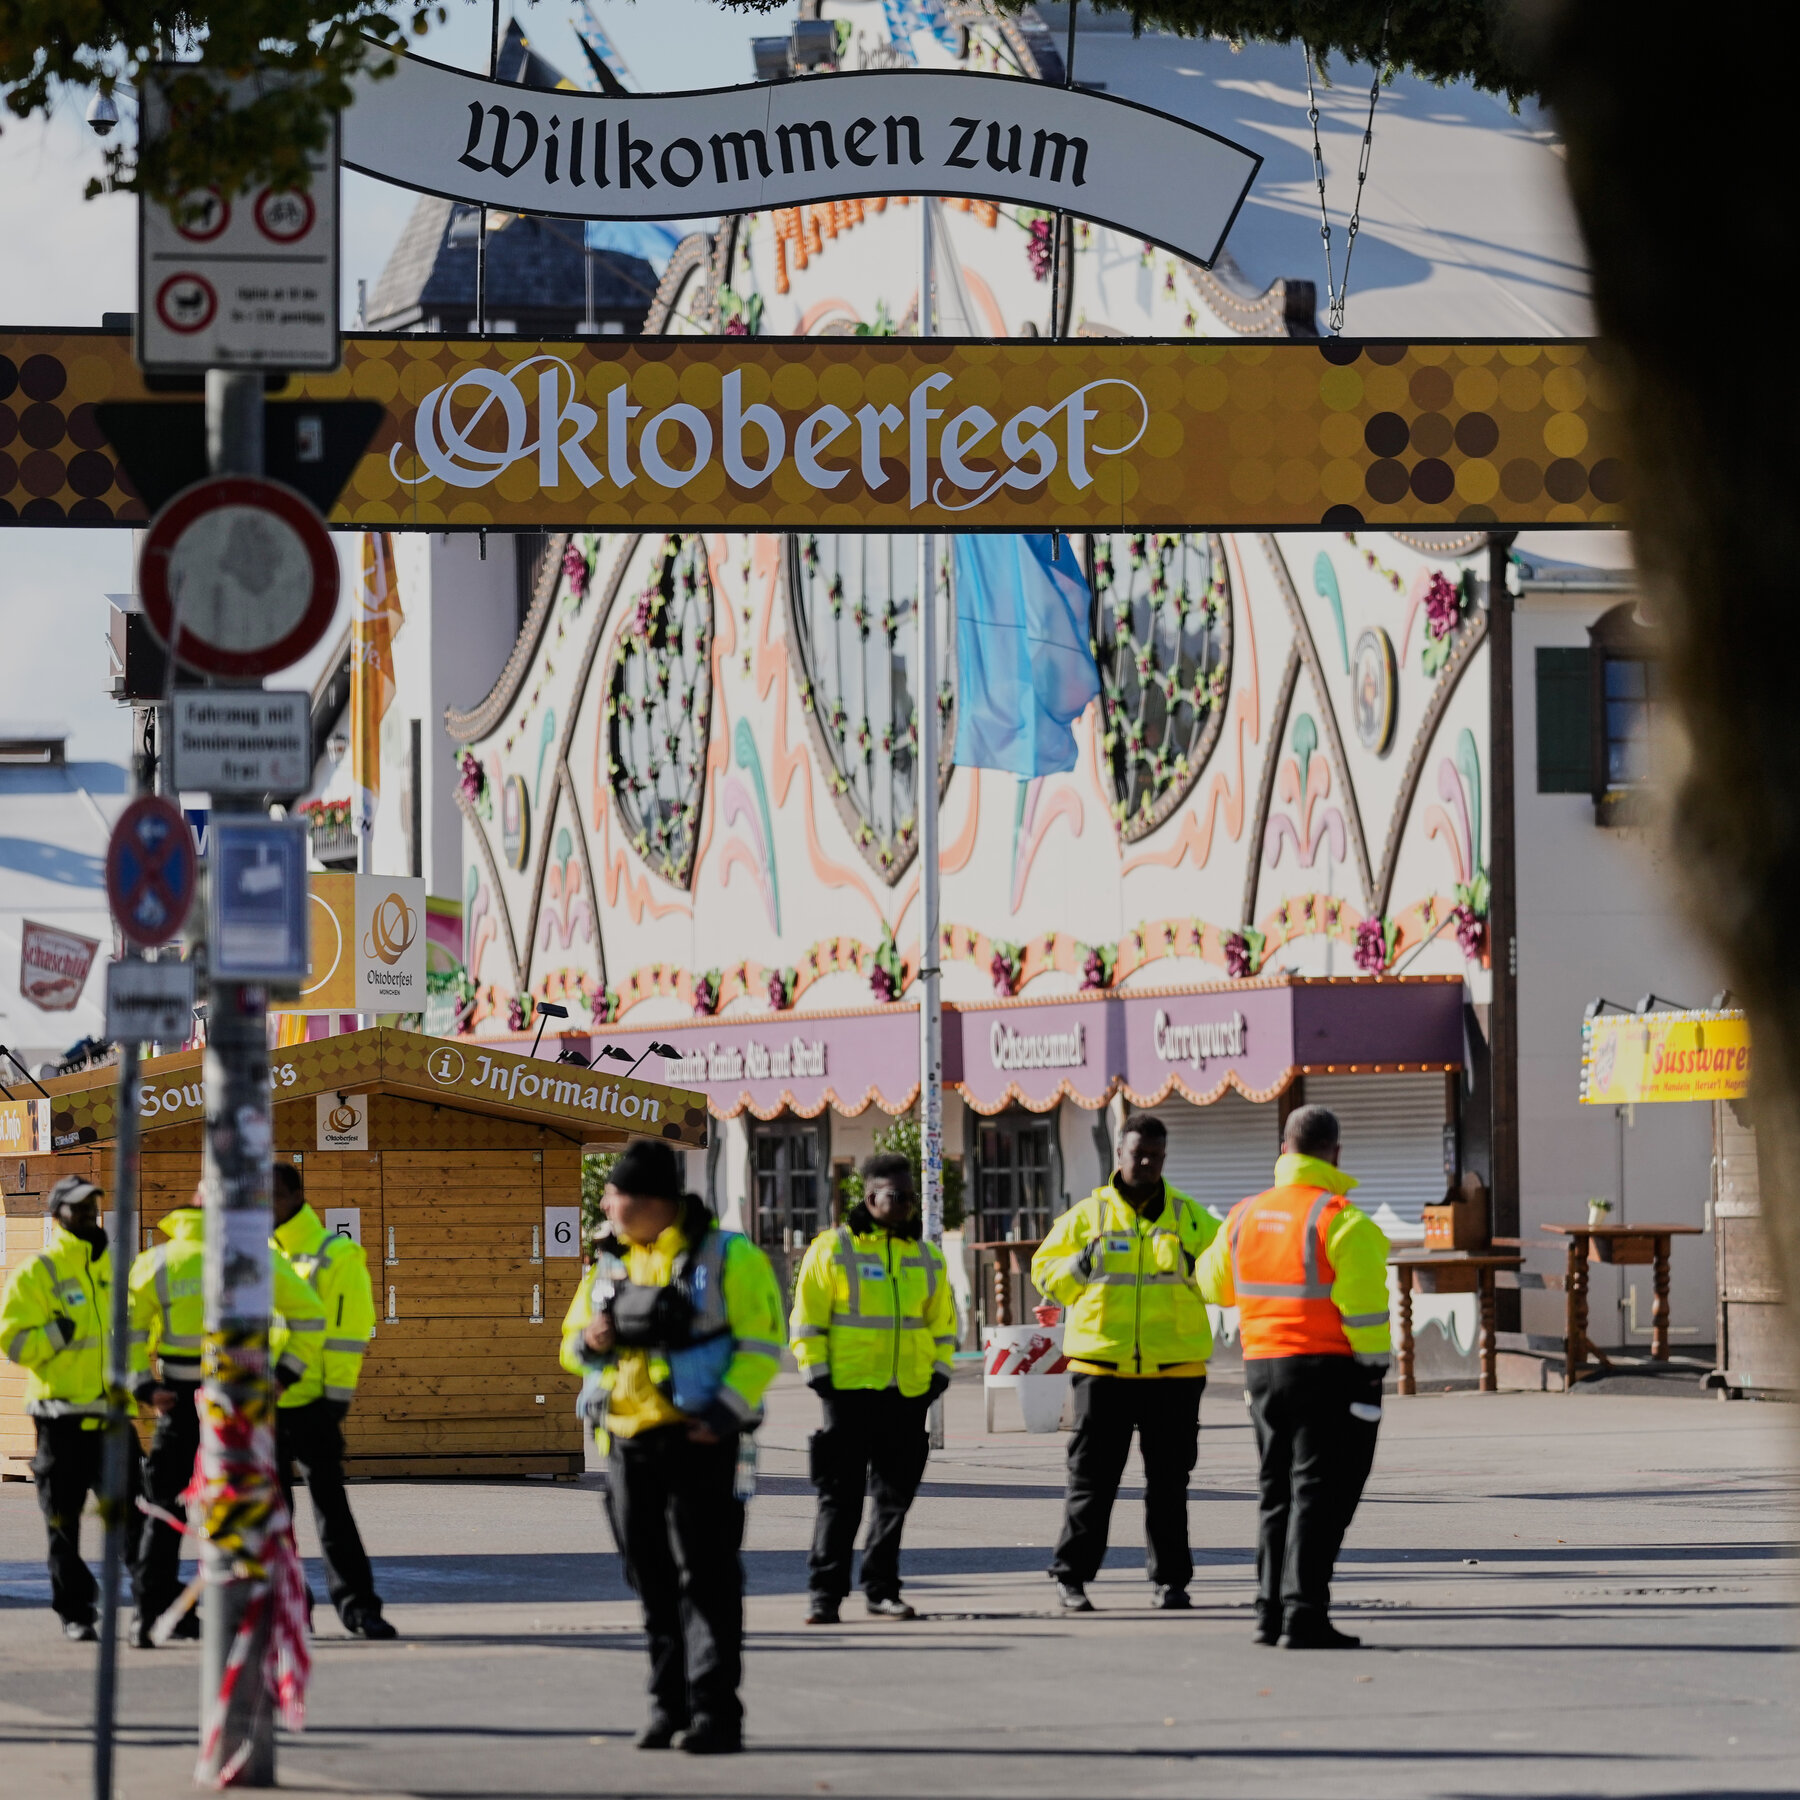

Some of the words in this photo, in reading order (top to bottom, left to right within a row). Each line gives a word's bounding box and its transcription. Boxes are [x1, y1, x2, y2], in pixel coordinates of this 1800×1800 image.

[457, 100, 924, 189] Willkommen
[942, 116, 1089, 188] zum
[390, 355, 1148, 511] Oktoberfest
[367, 969, 412, 988] Oktoberfest
[990, 1020, 1085, 1069] Ochsensemmel
[1154, 1008, 1245, 1070] Currywurst
[138, 1063, 297, 1117] Sours
[470, 1055, 660, 1123] Information
[336, 1222, 352, 1241] 5
[554, 1221, 571, 1244] 6
